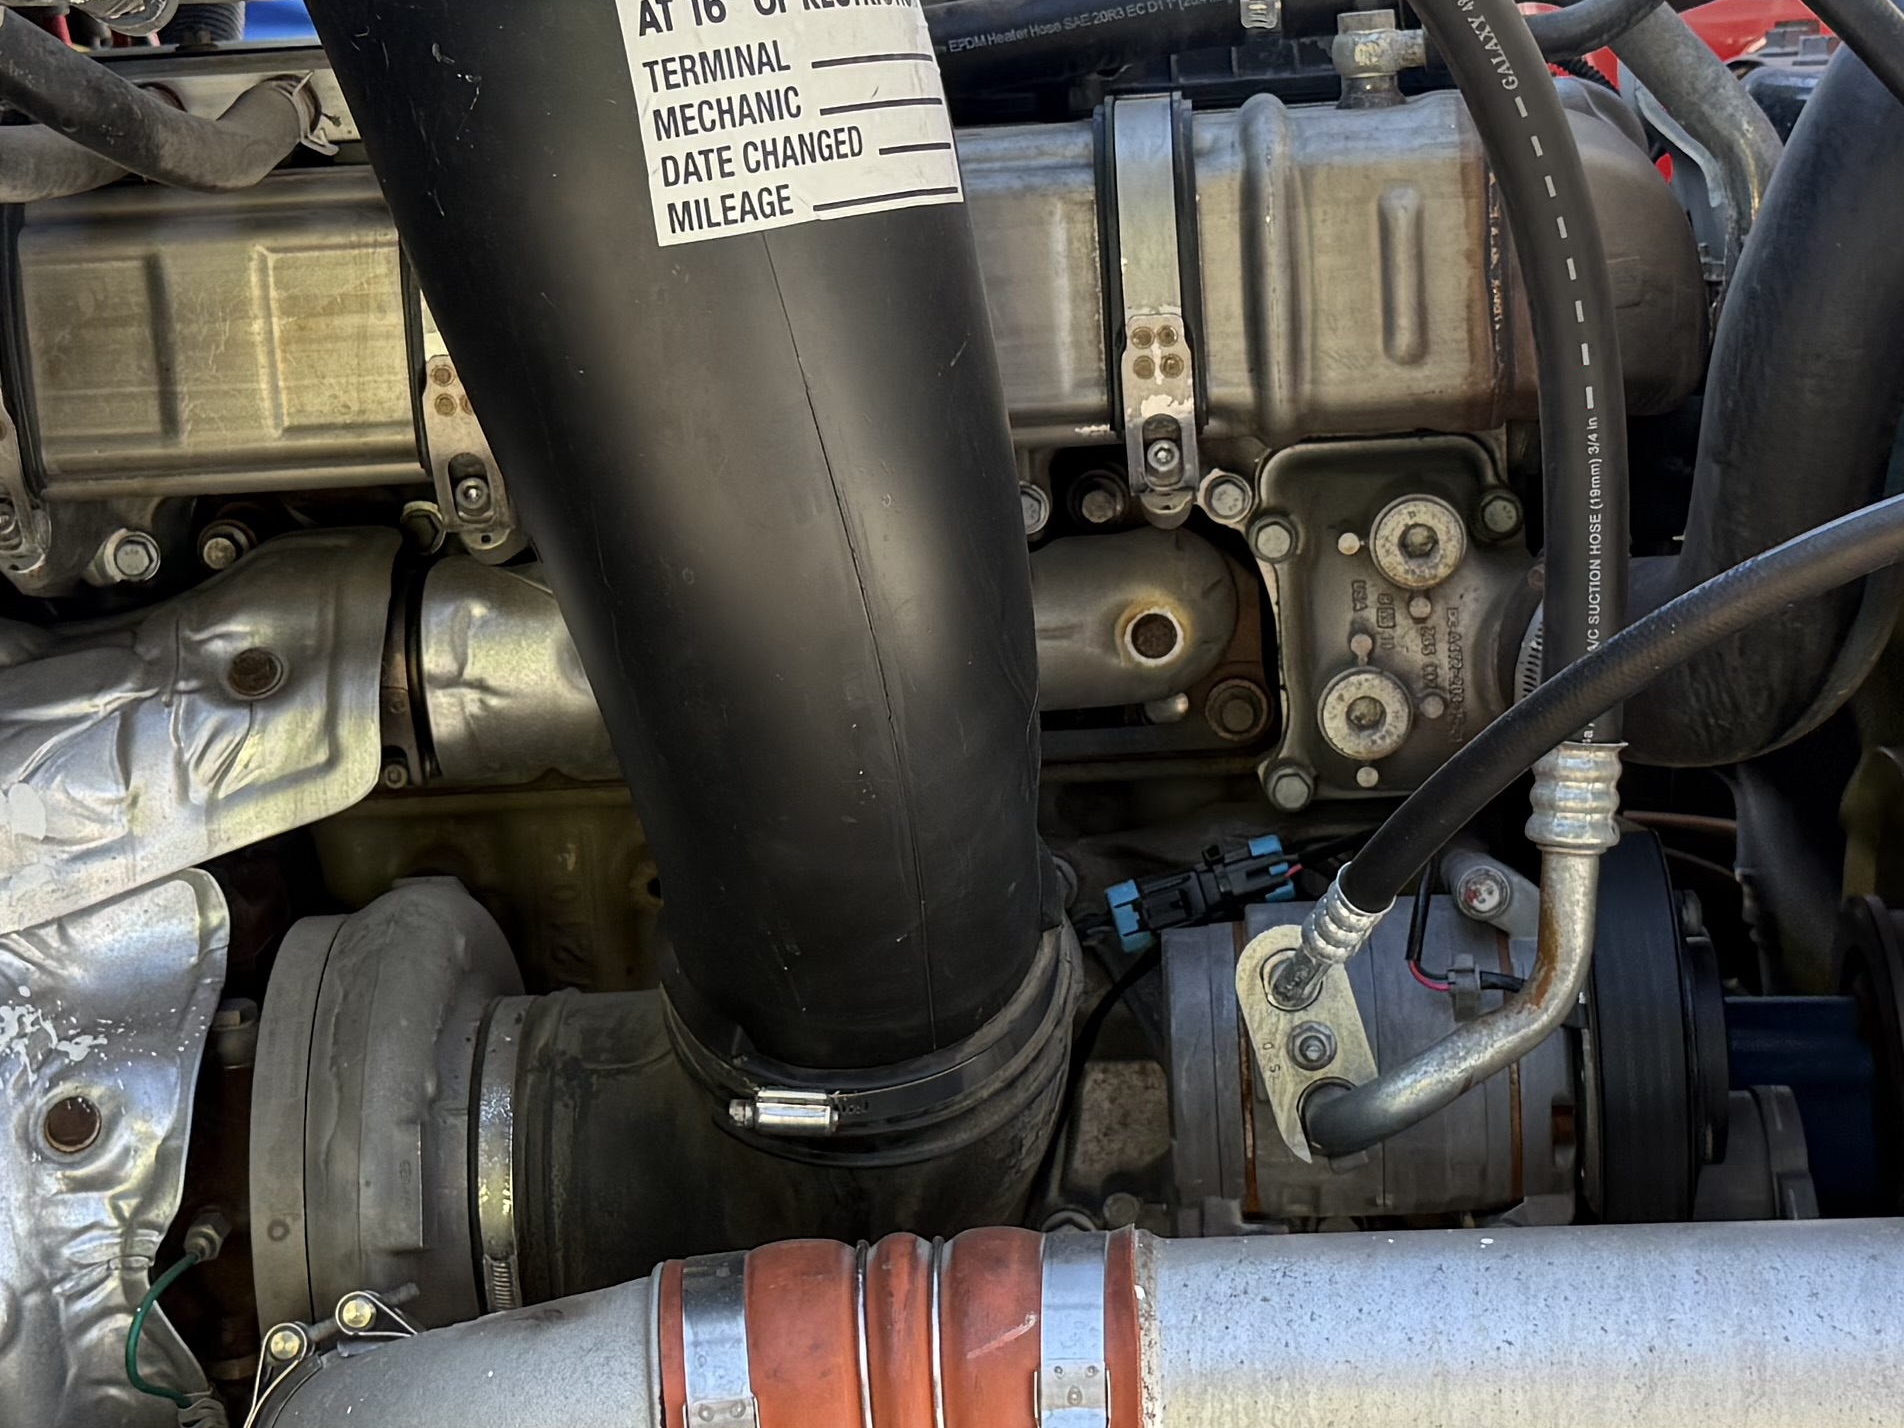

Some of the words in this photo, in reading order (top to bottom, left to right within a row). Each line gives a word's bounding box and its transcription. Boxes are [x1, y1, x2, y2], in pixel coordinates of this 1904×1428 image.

[948, 34, 988, 53] EPDM
[987, 27, 1029, 46] Heater
[1029, 22, 1062, 38] Hose
[1063, 13, 1091, 30] SAE
[1092, 6, 1126, 25] 20R3
[1126, 3, 1146, 18] EC
[1468, 15, 1519, 90] GALAXY
[642, 39, 791, 93] TERMINAL
[653, 86, 802, 141] MECHANIC
[661, 145, 735, 187] DATE
[743, 125, 863, 174] CHANGED
[667, 183, 794, 234] MILEAGE
[1587, 416, 1598, 430] in
[1588, 431, 1601, 456] 3/4
[1589, 458, 1603, 510] (19mm)
[1589, 513, 1602, 556] HOSE
[1352, 579, 1369, 612] USA
[1587, 558, 1602, 625] SUCTION
